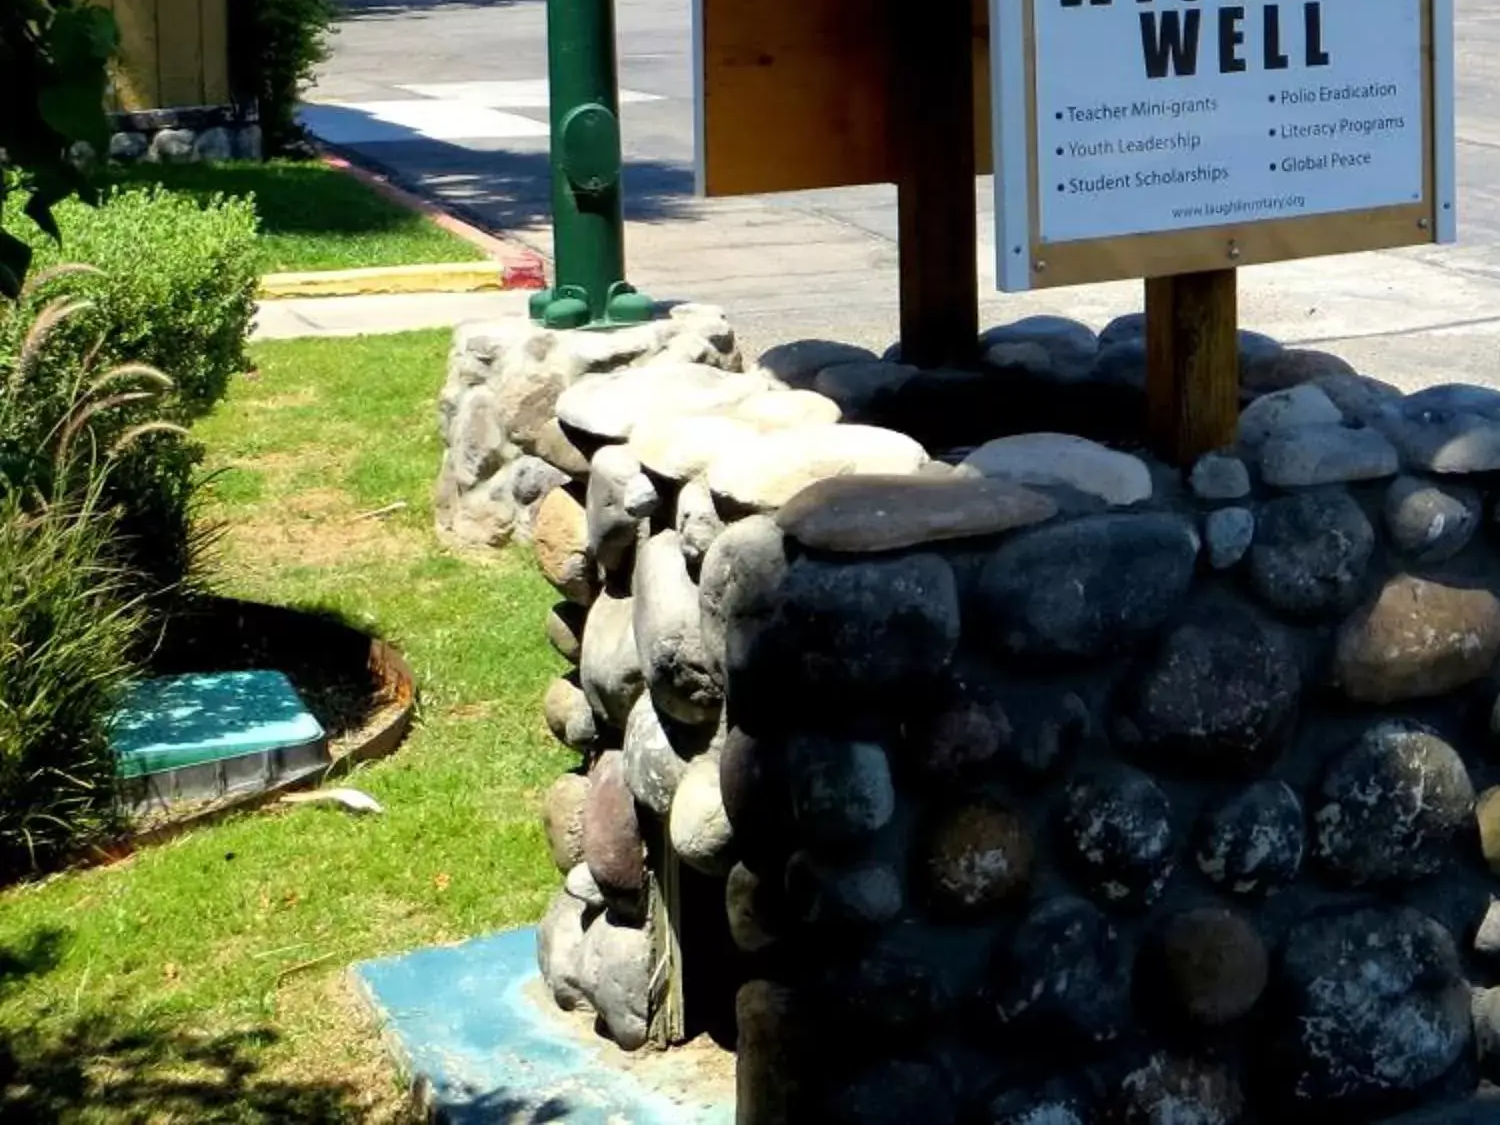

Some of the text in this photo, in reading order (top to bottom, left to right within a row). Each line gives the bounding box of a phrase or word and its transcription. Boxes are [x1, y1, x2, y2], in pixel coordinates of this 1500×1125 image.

[1140, 1, 1329, 79] WELL
[1281, 82, 1398, 105] Polio Eradication
[1067, 97, 1218, 123] Teacher Mini-grants
[1281, 115, 1406, 140] Literacy Programs
[1068, 131, 1202, 157] Youth Leadership
[1281, 150, 1373, 172] Global Peace
[1068, 163, 1230, 194] Student Scholarships
